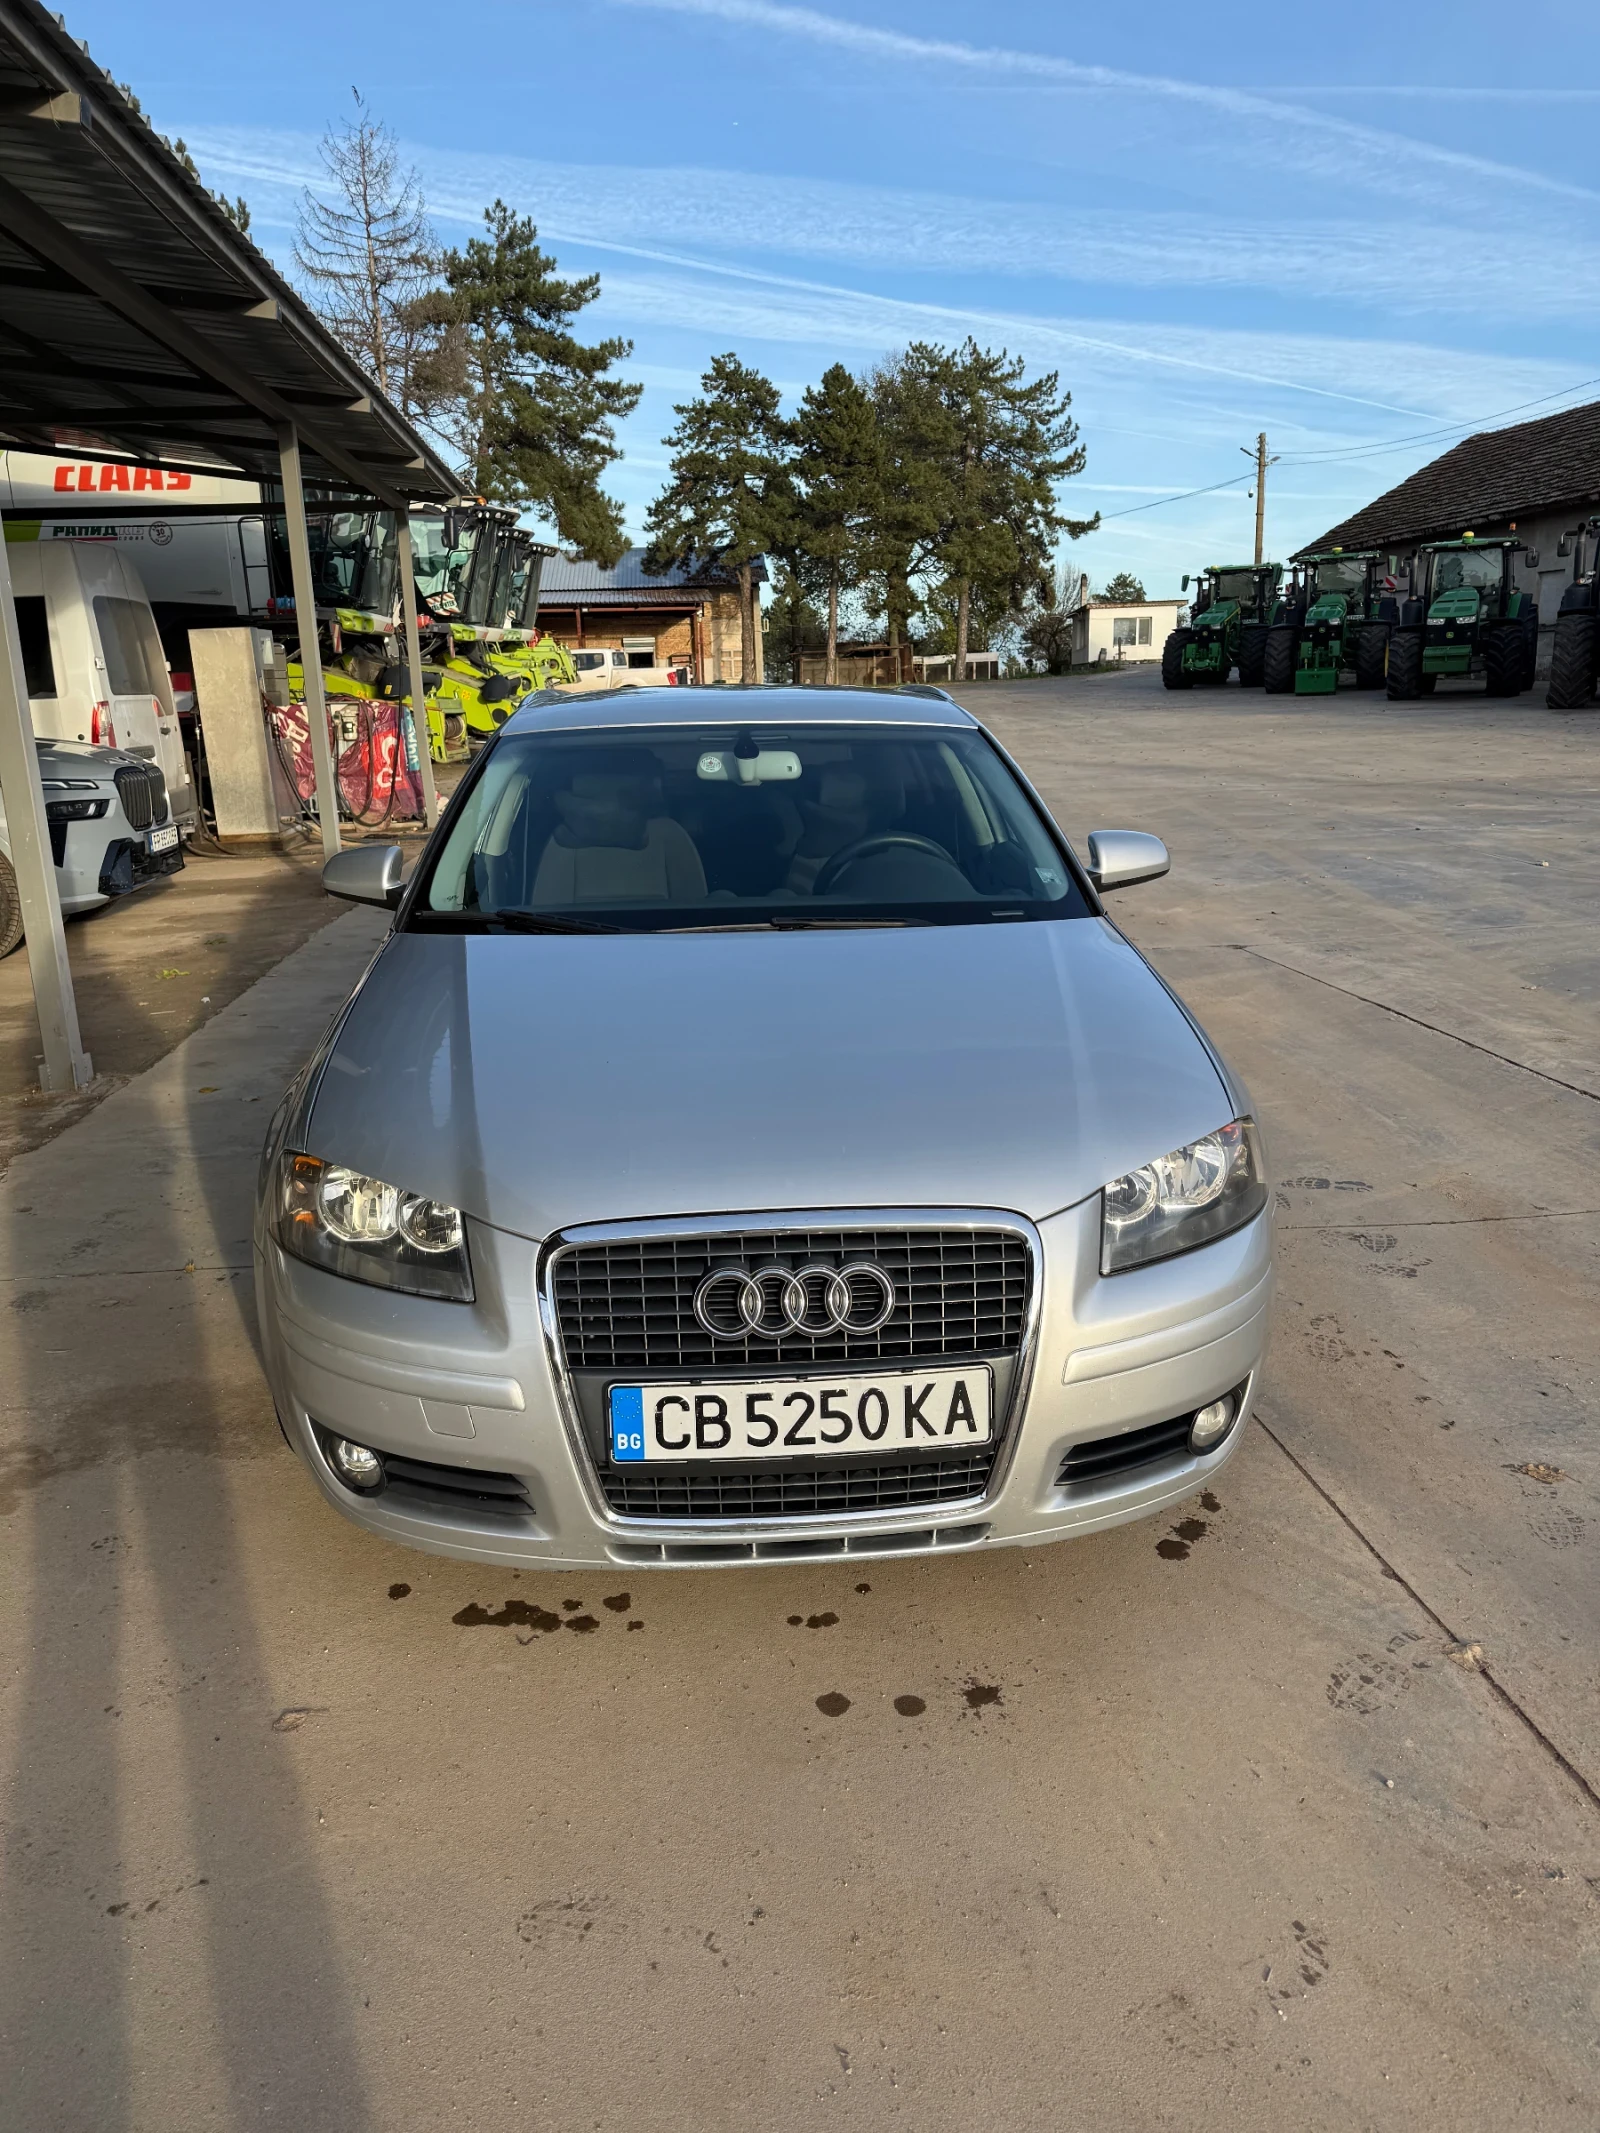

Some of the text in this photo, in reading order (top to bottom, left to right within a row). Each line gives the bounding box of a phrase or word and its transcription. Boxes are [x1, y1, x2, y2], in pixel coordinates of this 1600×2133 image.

[54, 465, 192, 492] CLAAS
[53, 526, 118, 537] РАПИД
[655, 1380, 978, 1450] CB 5250 KA
[617, 1433, 641, 1450] BG
